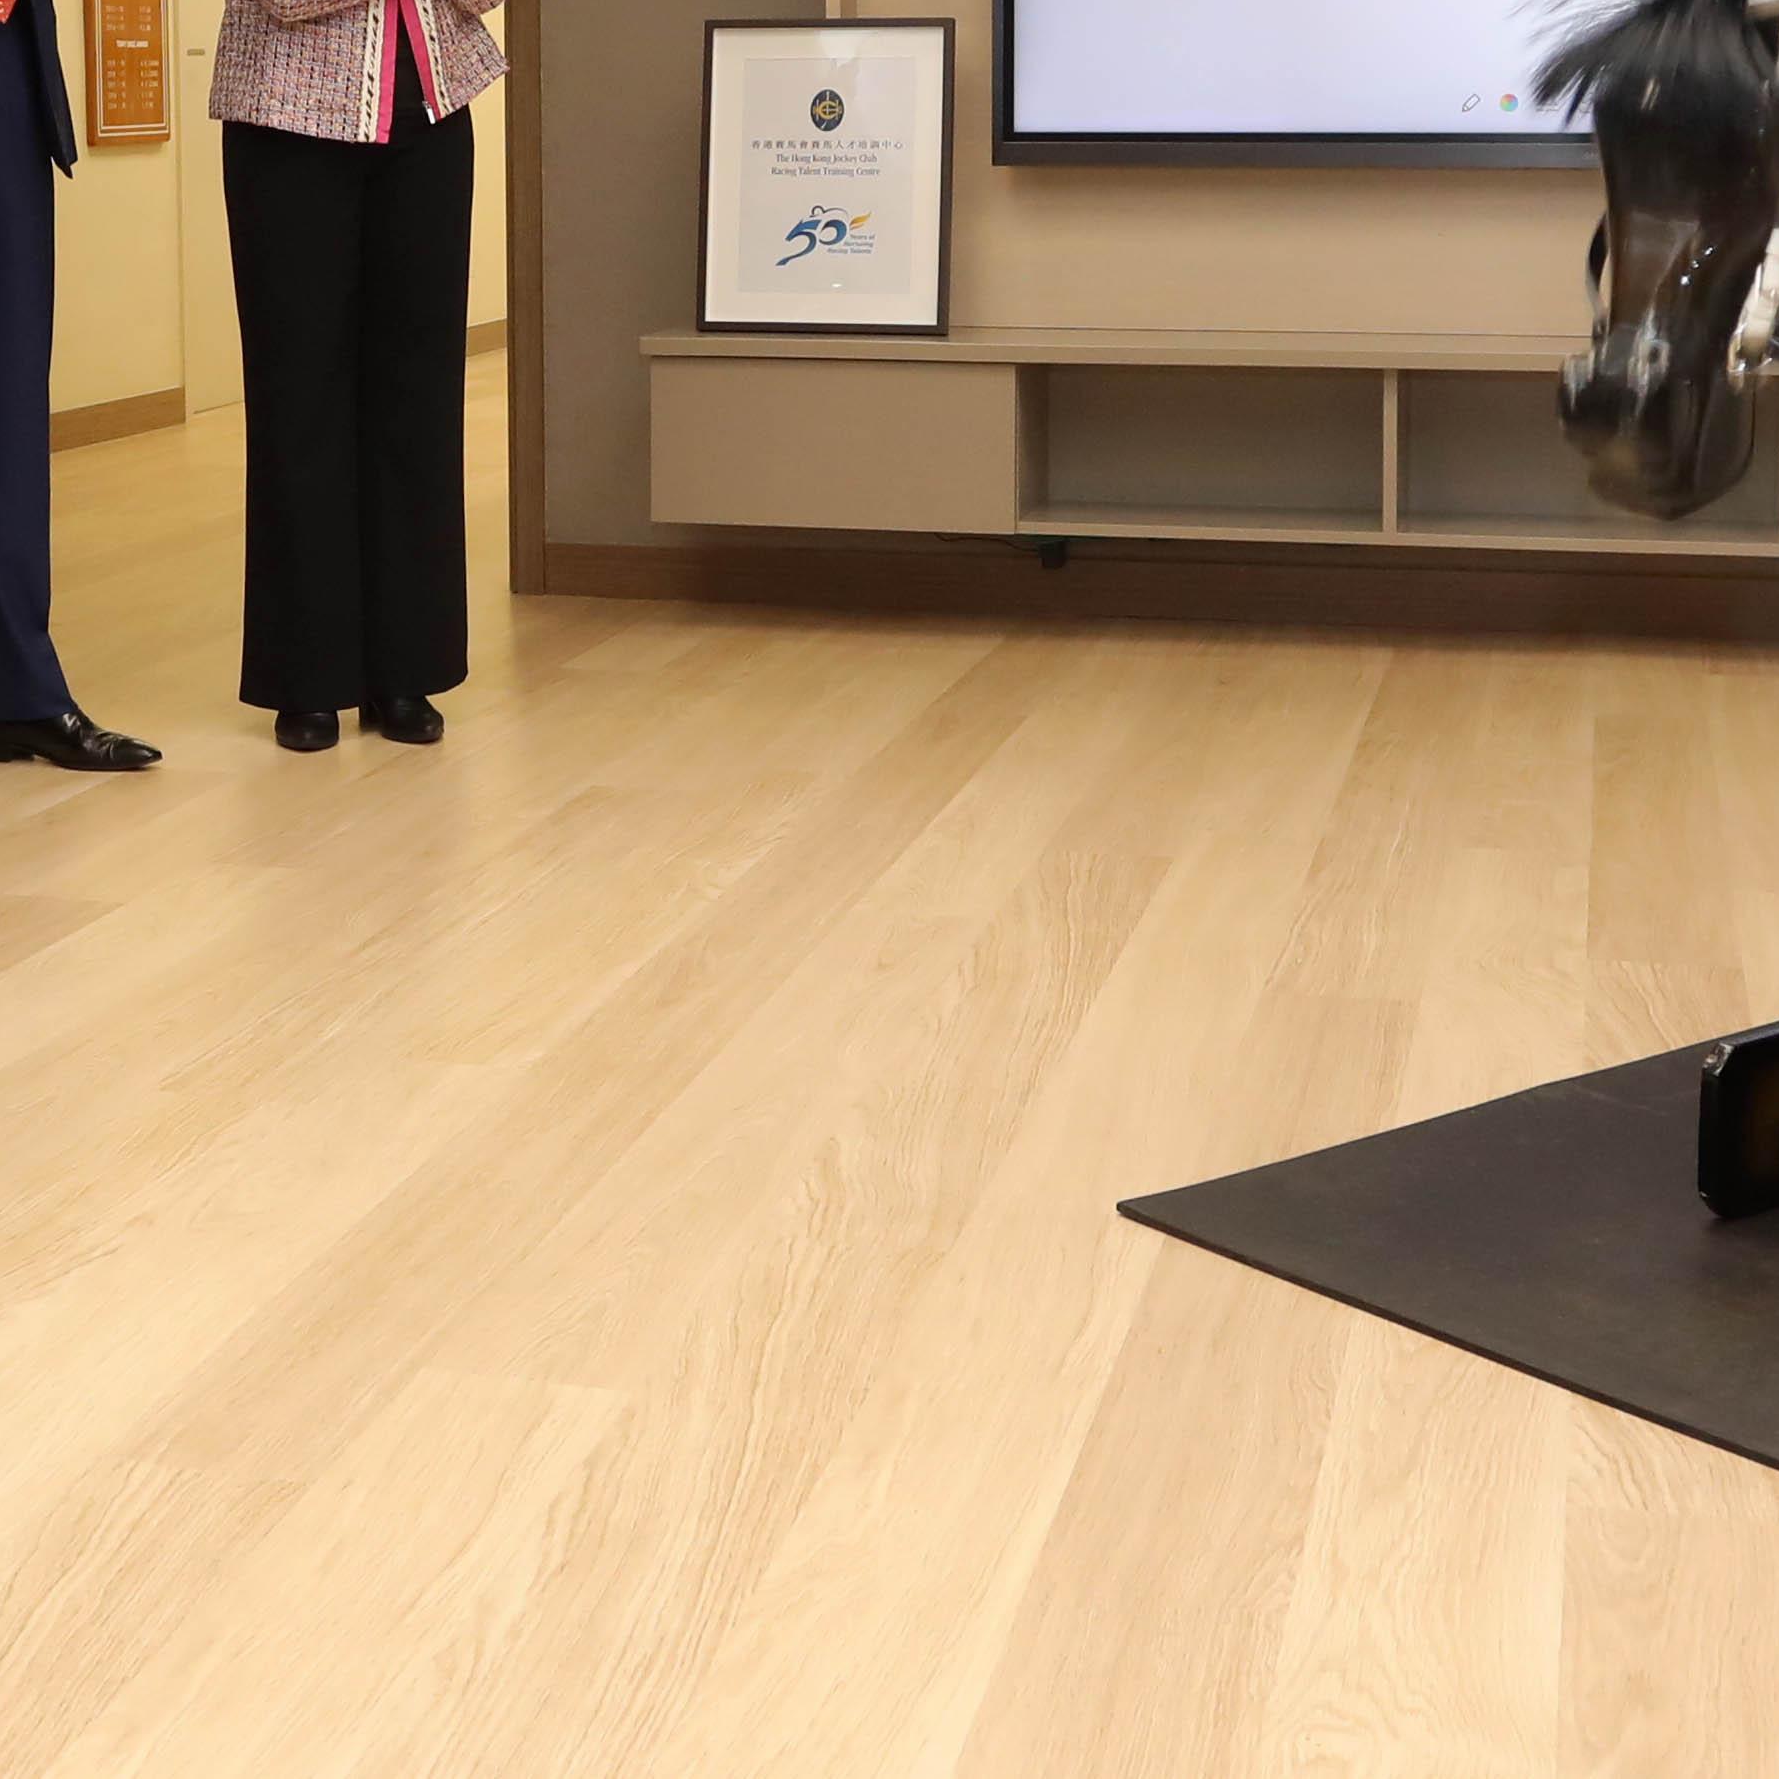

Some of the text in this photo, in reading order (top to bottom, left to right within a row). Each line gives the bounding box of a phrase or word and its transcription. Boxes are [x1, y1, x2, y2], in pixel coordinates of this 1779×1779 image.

[775, 153, 877, 164] The Hong Kong Jockey Club
[771, 166, 797, 177] Racing
[855, 166, 880, 175] Centre
